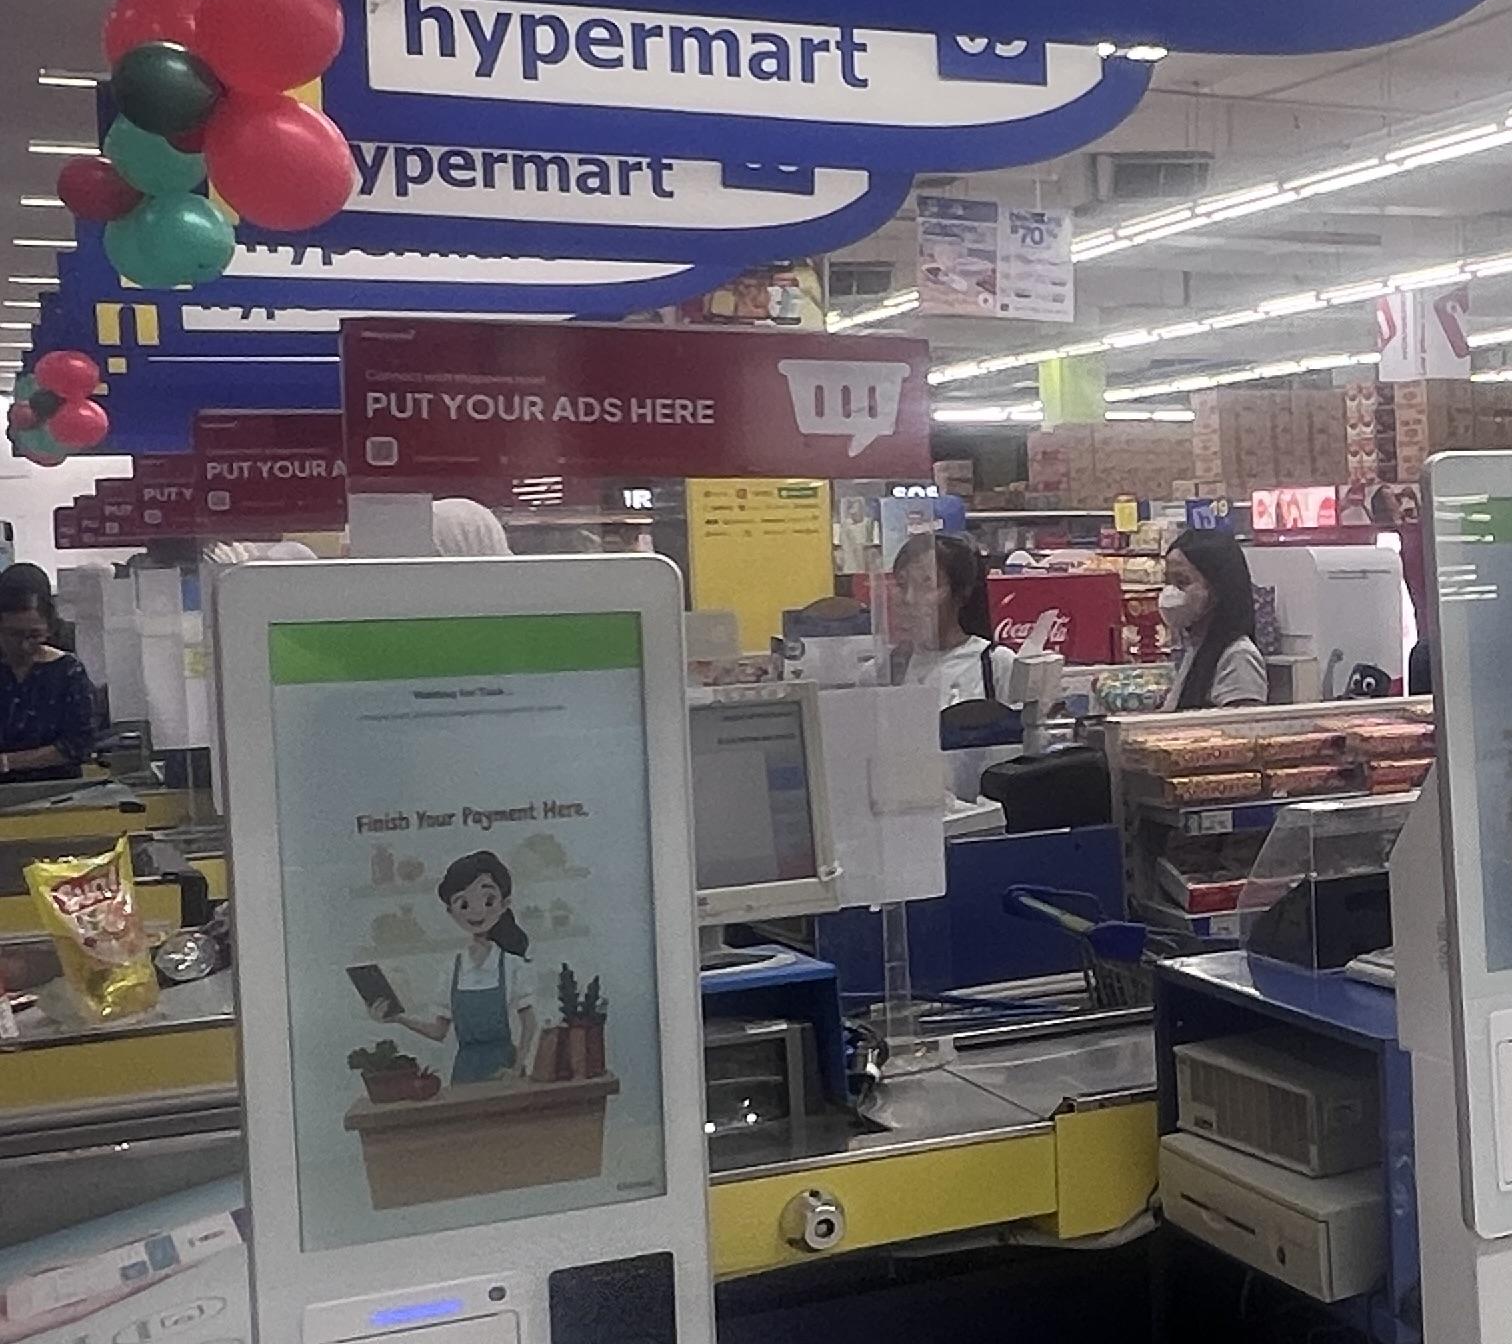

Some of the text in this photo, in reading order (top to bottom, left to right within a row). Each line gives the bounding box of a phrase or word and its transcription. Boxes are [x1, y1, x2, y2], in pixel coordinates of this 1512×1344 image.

[352, 142, 676, 198] ypermart
[366, 391, 715, 425] PUT YOUR ADS HERE
[205, 461, 252, 480] PUT
[257, 460, 327, 479] YOUR
[356, 811, 410, 834] Finish
[416, 810, 456, 830] Your
[462, 801, 536, 832] Payment
